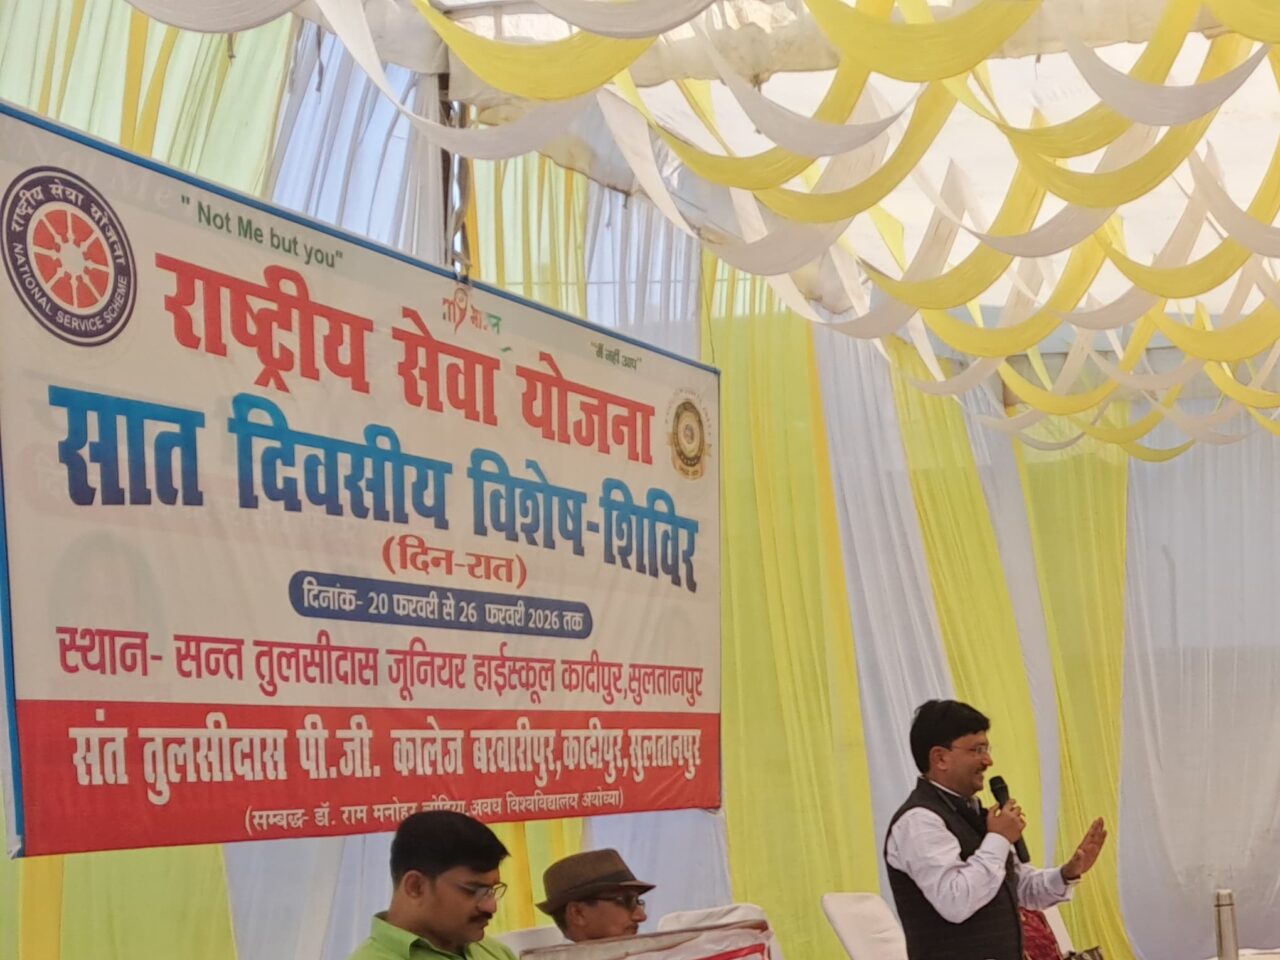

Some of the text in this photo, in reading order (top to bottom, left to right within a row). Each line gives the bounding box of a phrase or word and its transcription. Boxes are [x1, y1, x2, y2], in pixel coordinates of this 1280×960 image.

[198, 200, 232, 233] Not
[238, 216, 264, 244] Me
[270, 229, 299, 257] but
[12, 242, 128, 332] NATIONAL SERVICE SCHEME
[155, 252, 373, 394] राष्ट्रीय
[392, 306, 501, 427] सेवा
[515, 351, 655, 465] योजना
[48, 384, 205, 507] सात
[227, 392, 452, 530] दिवसीय
[382, 534, 527, 589] (दिन-रात)
[367, 592, 389, 615] 20
[392, 591, 439, 620] फरवरी
[442, 592, 455, 621] से
[459, 602, 478, 623] 26
[485, 600, 525, 628] फरवरी
[527, 610, 560, 631] 2026
[562, 611, 584, 632] तक
[173, 633, 244, 681] सन्त
[252, 629, 379, 697] तुलसीदास
[386, 636, 467, 702] जूनियर
[473, 641, 556, 704] हाईस्कूल
[68, 708, 129, 786] संत
[137, 712, 288, 806] तुलसीदास
[390, 716, 464, 777] कालेज
[340, 805, 368, 825] राम
